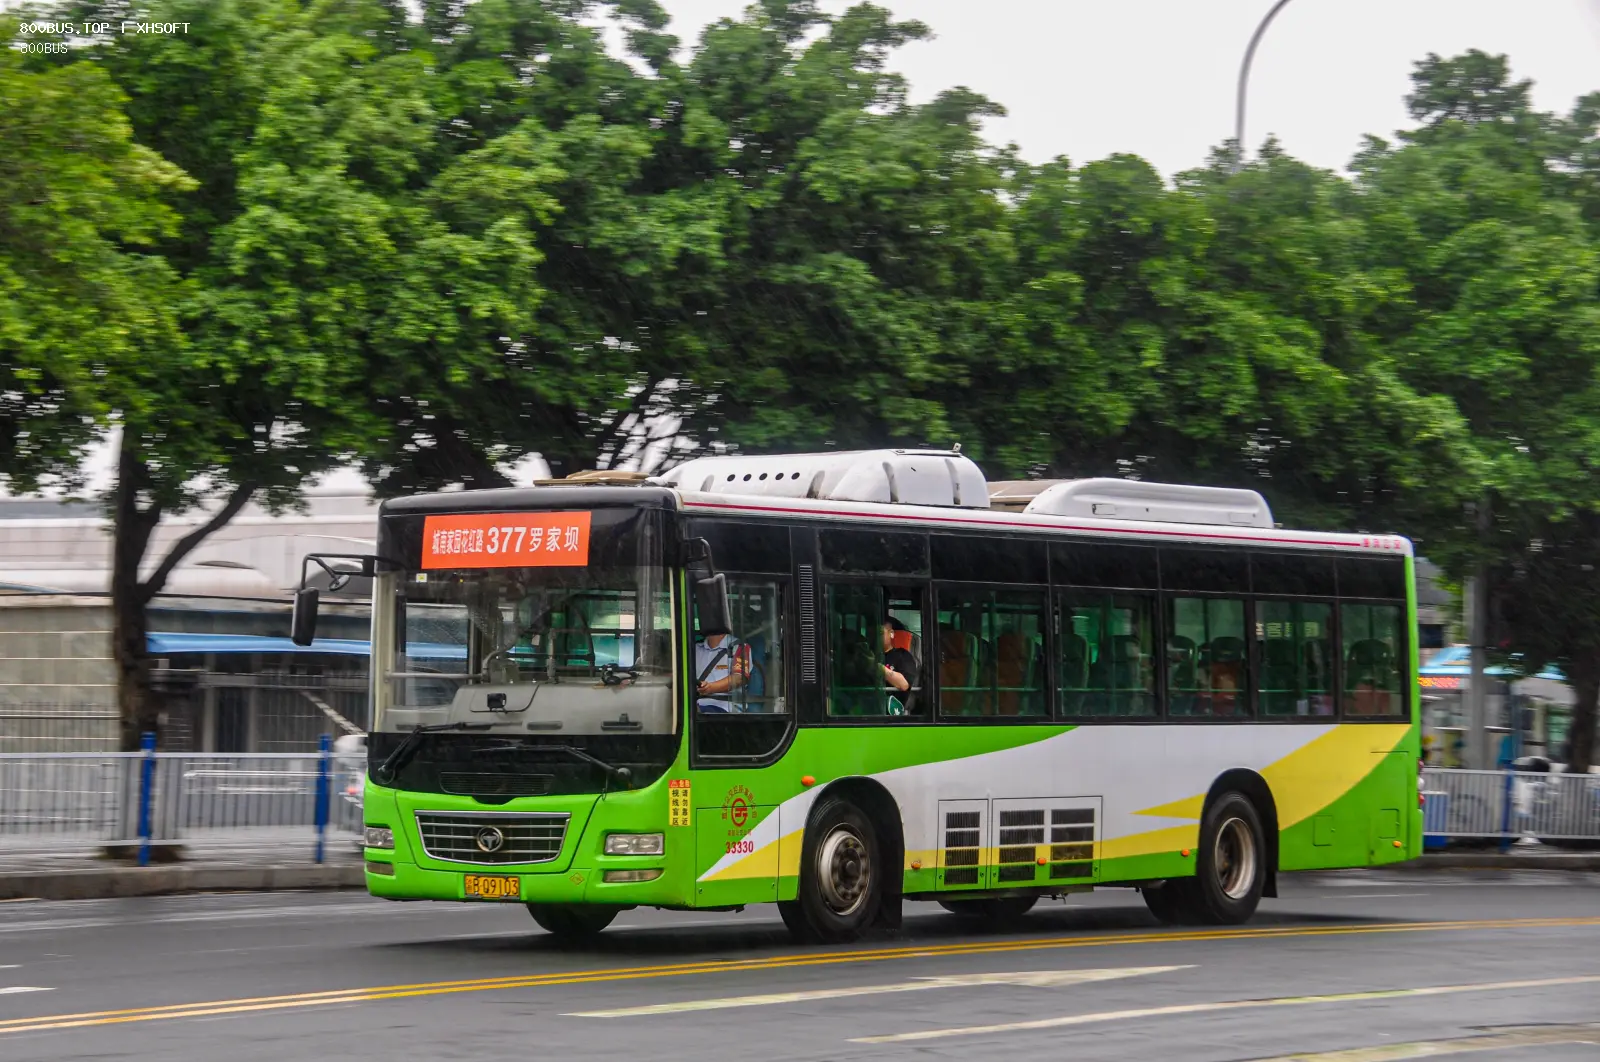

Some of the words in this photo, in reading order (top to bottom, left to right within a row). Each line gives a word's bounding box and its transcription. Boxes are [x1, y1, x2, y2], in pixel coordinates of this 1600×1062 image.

[486, 526, 527, 554] 377
[528, 526, 580, 552] 罗家坝
[672, 788, 680, 826] 视线盲区
[725, 840, 754, 854] 33330
